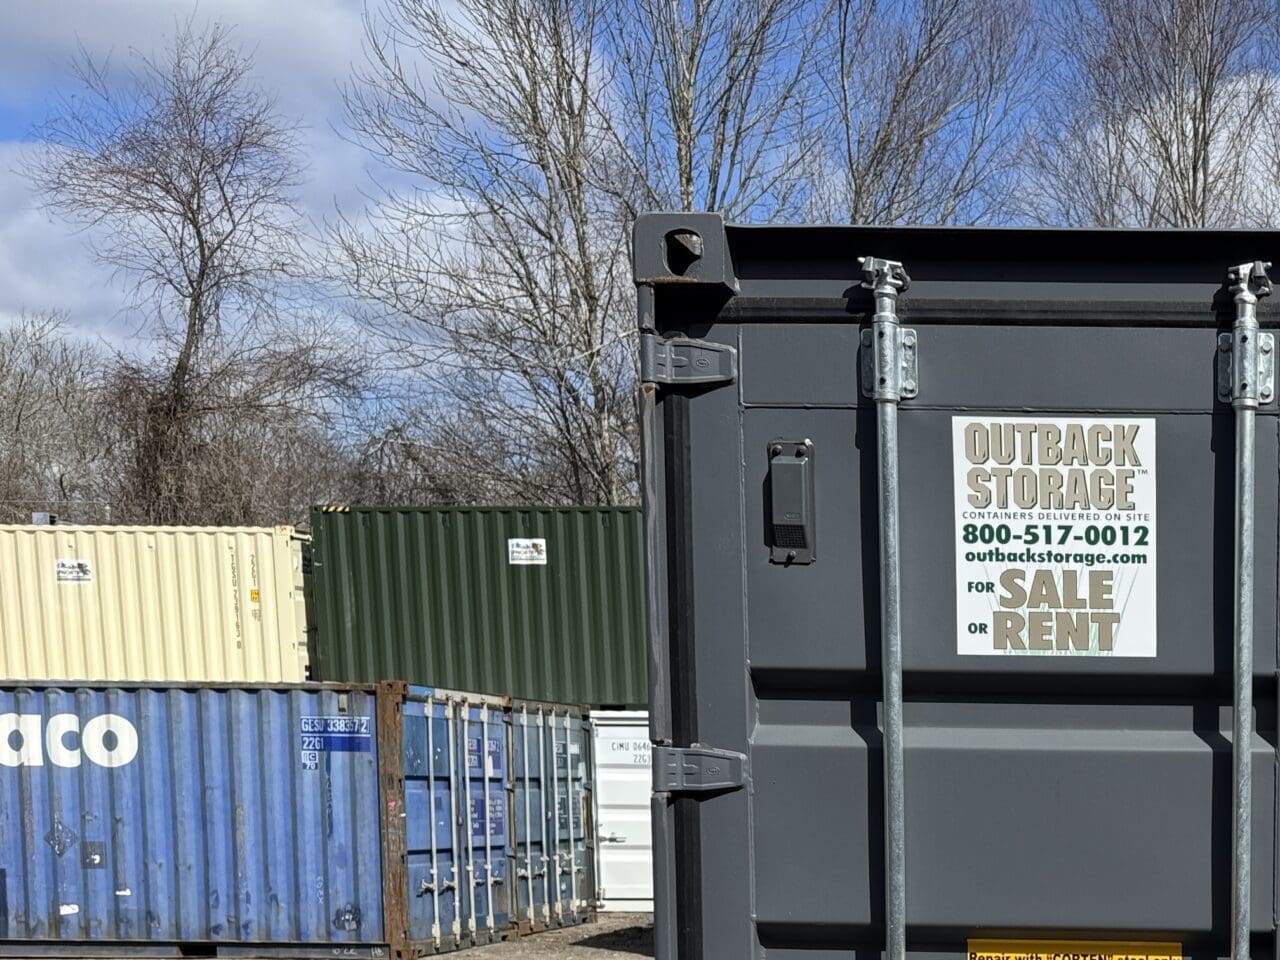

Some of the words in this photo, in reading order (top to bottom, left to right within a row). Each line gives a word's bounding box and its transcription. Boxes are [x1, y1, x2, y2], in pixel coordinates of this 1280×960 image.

[964, 422, 1141, 466] OUTBACK
[966, 467, 1135, 511] STORAGE
[962, 511, 1033, 520] CONTAINERS
[1038, 512, 1100, 521] DELIVERED
[1105, 513, 1121, 521] ON
[1126, 513, 1150, 521] SITE
[962, 524, 1149, 546] 800-517-0012
[965, 547, 1147, 566] outbackstorage.com
[967, 581, 995, 593] FOR
[999, 568, 1113, 610] SALE
[968, 623, 988, 634] OR
[992, 611, 1120, 651] RENT
[302, 737, 324, 750] 22G1
